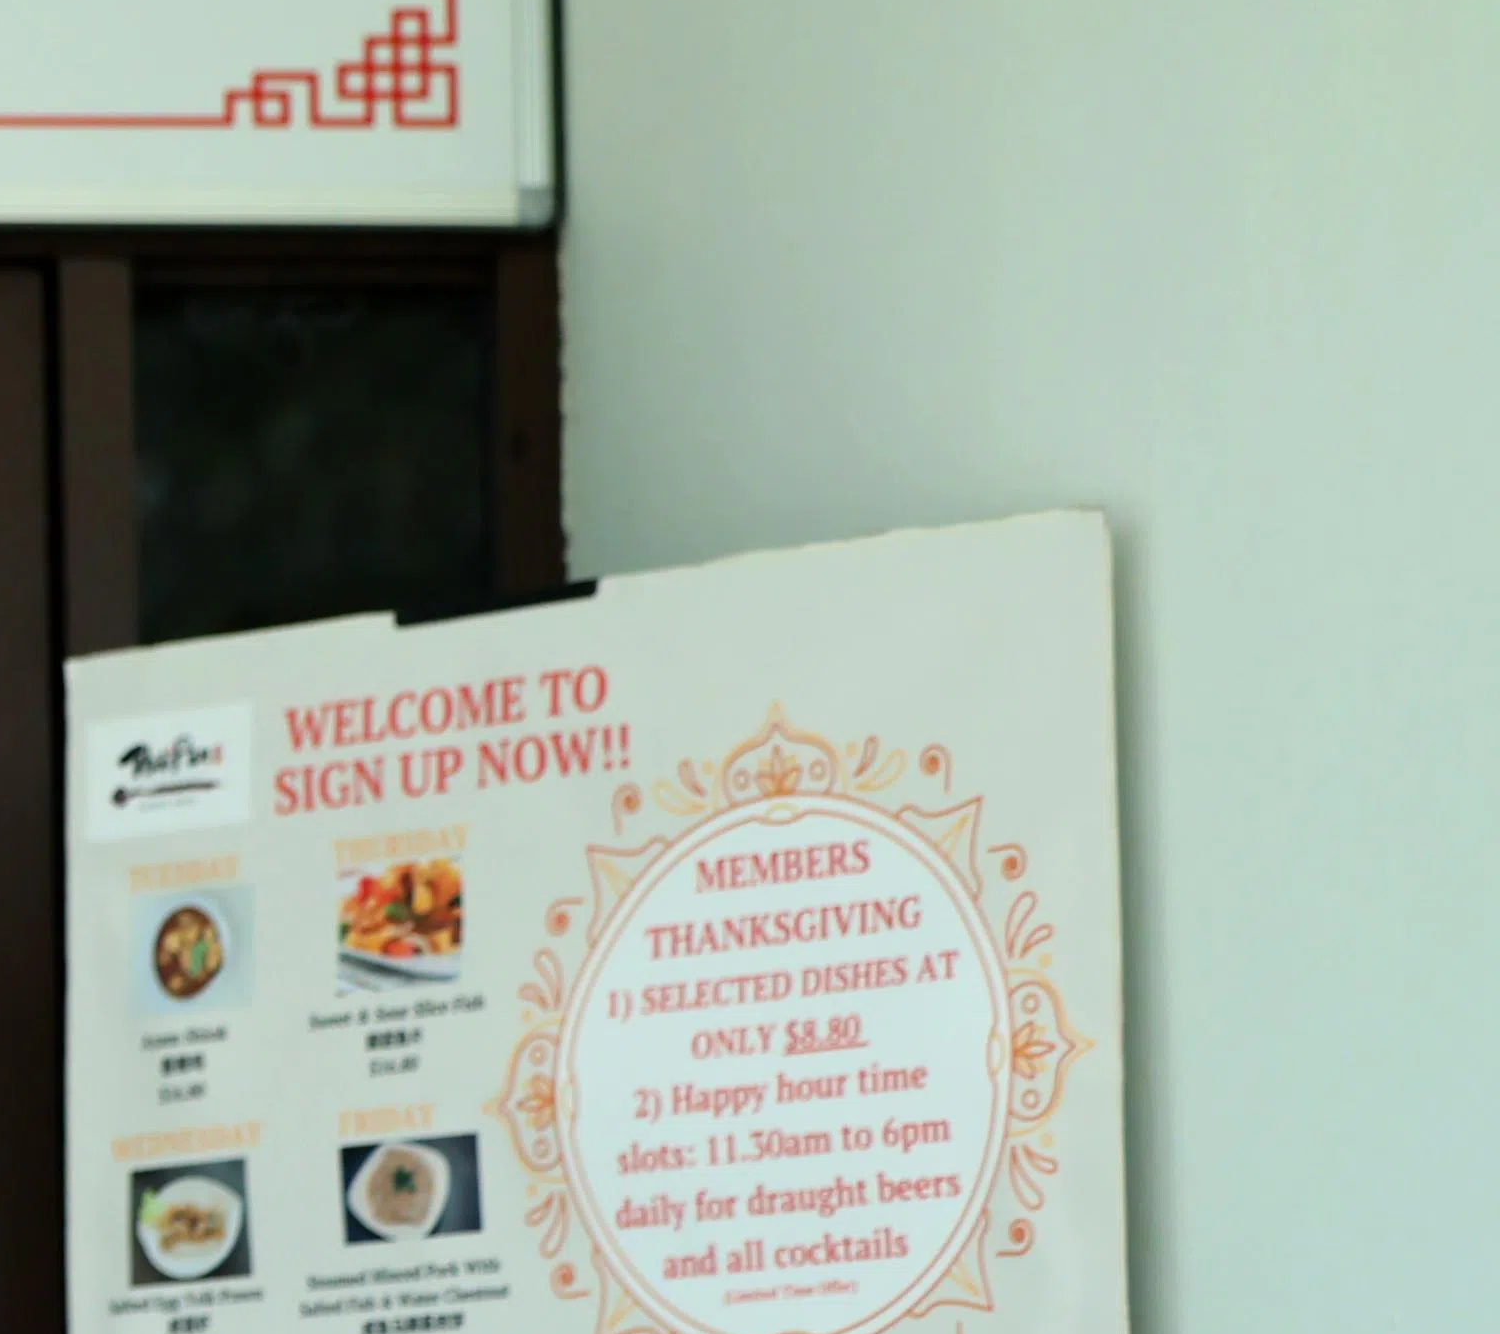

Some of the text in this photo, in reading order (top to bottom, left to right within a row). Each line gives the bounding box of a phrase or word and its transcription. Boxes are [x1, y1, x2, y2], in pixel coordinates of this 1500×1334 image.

[285, 665, 608, 751] WELCOME TO
[274, 723, 629, 815] SIGN UP NOW!!
[696, 840, 870, 890] MEMBERS
[645, 895, 921, 959] THANKSGIVING
[608, 949, 959, 1021] 1) SELECTED DISHES AT
[690, 1024, 775, 1059] ONLY
[633, 1063, 928, 1123] 2) Happy hour time
[616, 1117, 951, 1175] slots: 11.30am to 6pm
[614, 1171, 961, 1232] daily for draught beers
[662, 1226, 908, 1279] and all cocktails
